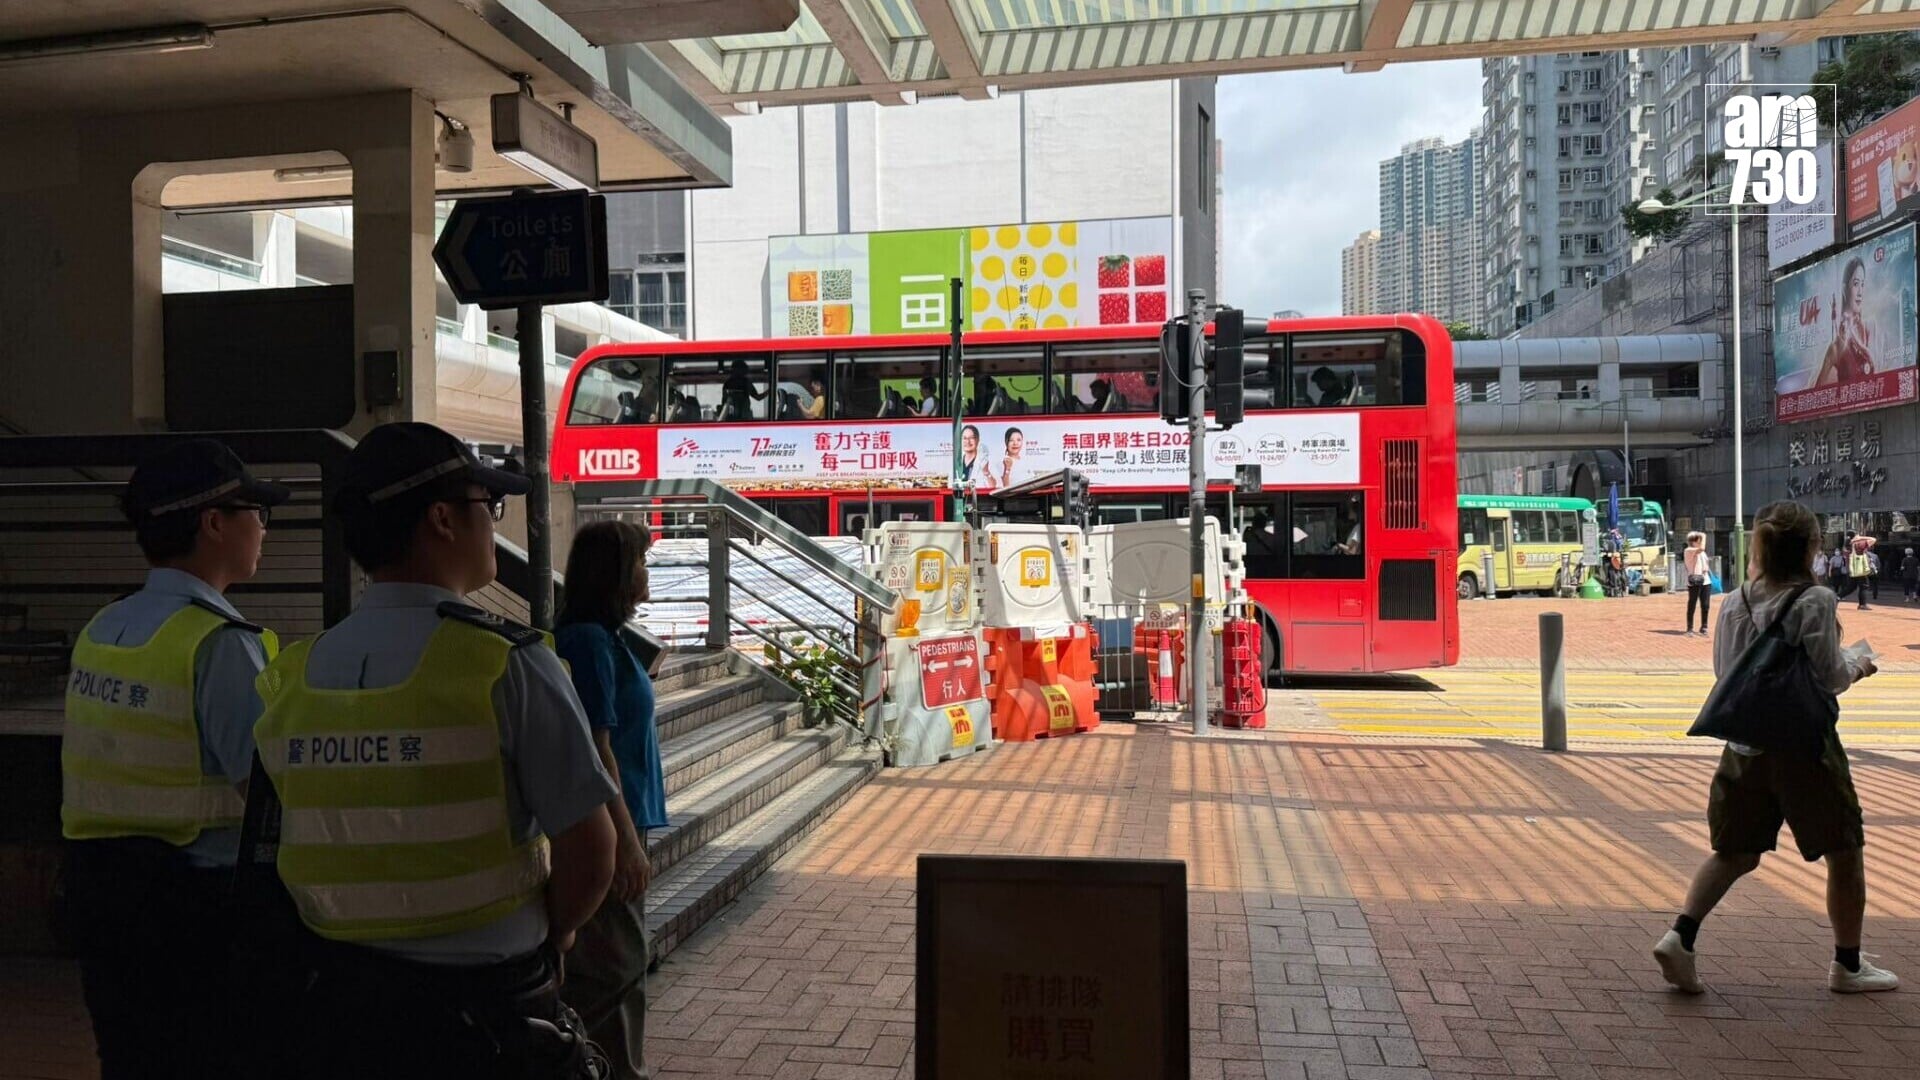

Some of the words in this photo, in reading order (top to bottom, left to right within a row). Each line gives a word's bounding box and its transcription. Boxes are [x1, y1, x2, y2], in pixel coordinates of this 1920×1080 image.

[488, 211, 574, 238] Toilets
[815, 431, 892, 450] 奮力守護
[1062, 431, 1192, 449] 無國界醫生日202
[579, 448, 641, 476] KMB
[821, 451, 918, 471] 每一口呼吸
[921, 640, 976, 656] PEDESTRIANS
[73, 669, 123, 703] POLICE
[128, 684, 149, 709] 察
[943, 678, 967, 699] 行人
[288, 738, 304, 764] 警
[312, 737, 389, 764] POLICE
[400, 735, 422, 762] 察
[1008, 1015, 1095, 1063] 購買
